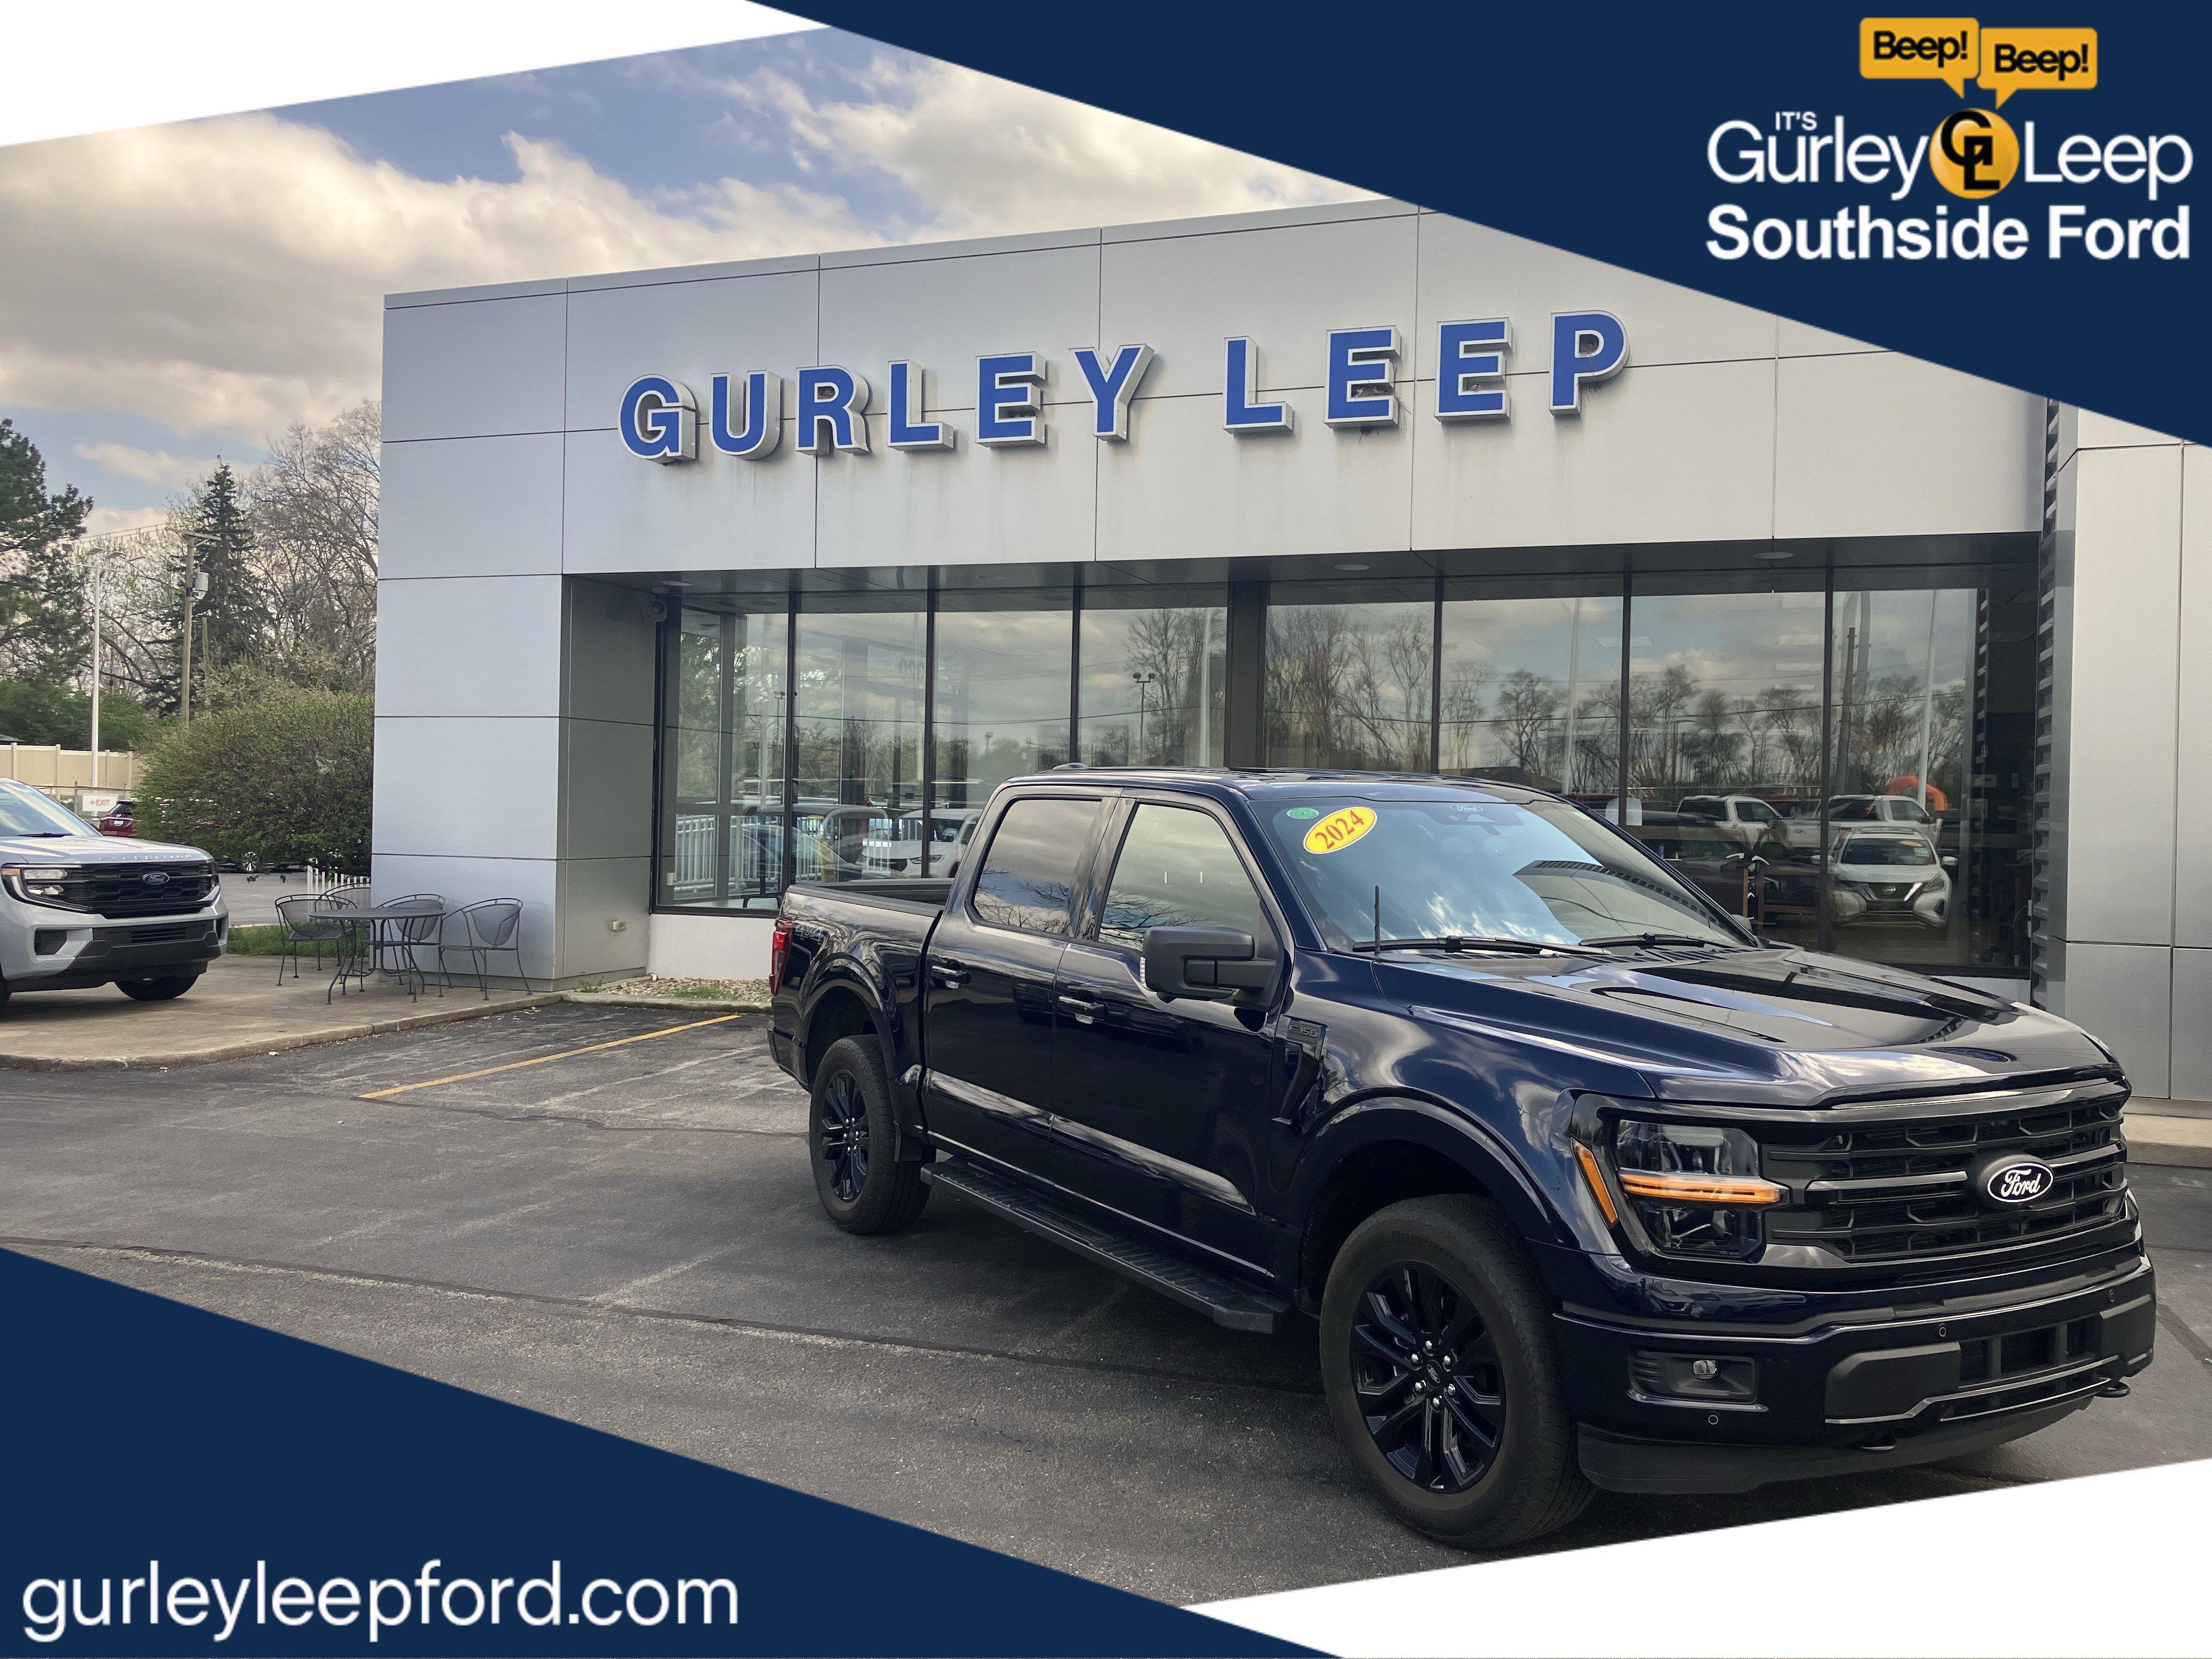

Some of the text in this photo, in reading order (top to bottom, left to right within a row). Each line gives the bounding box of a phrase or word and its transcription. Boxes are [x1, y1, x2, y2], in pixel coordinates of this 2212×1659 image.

[617, 310, 1630, 462] GURLEY LEEP
[1315, 810, 1365, 850] 2024
[1289, 1024, 1319, 1037] F-150
[2001, 1169, 2041, 1197] Ford
